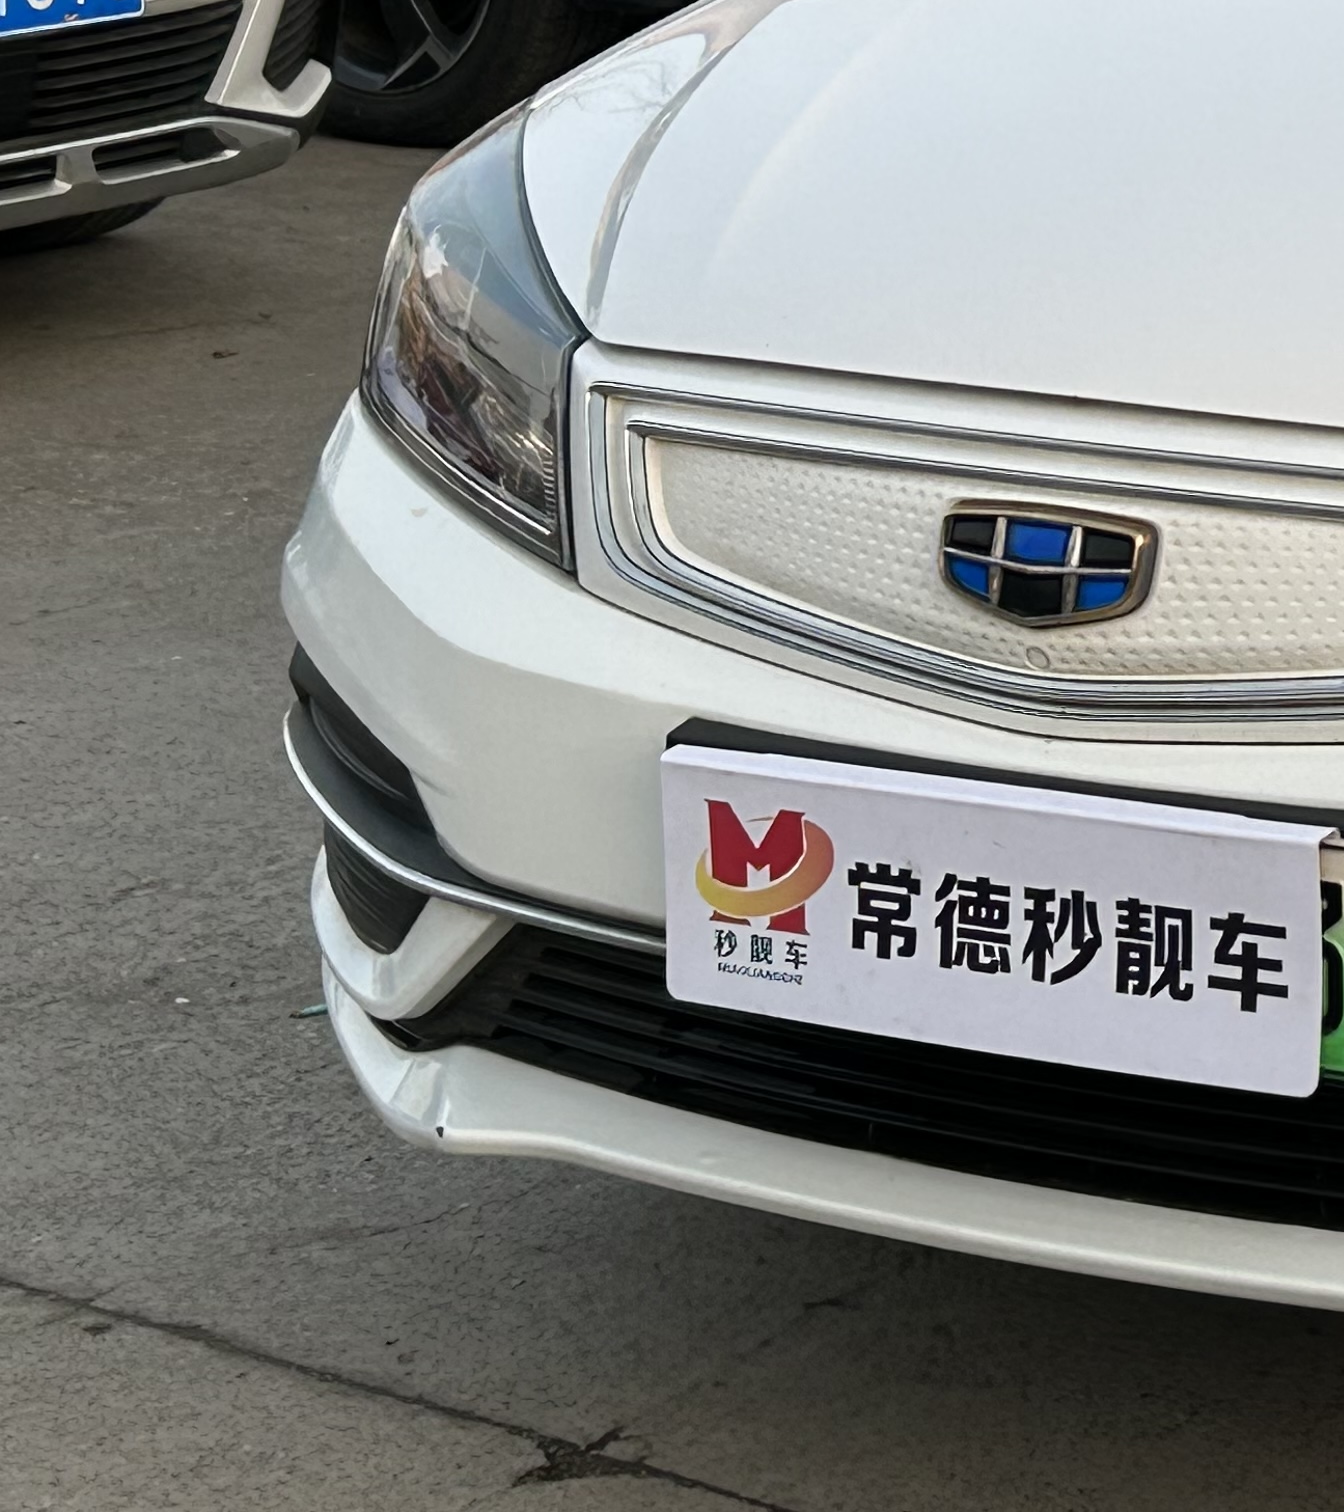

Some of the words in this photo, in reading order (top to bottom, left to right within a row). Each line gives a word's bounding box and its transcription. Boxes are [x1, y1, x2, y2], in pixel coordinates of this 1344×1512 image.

[713, 929, 808, 970] 秒靓车
[847, 861, 1289, 1014] 常德秒靓车
